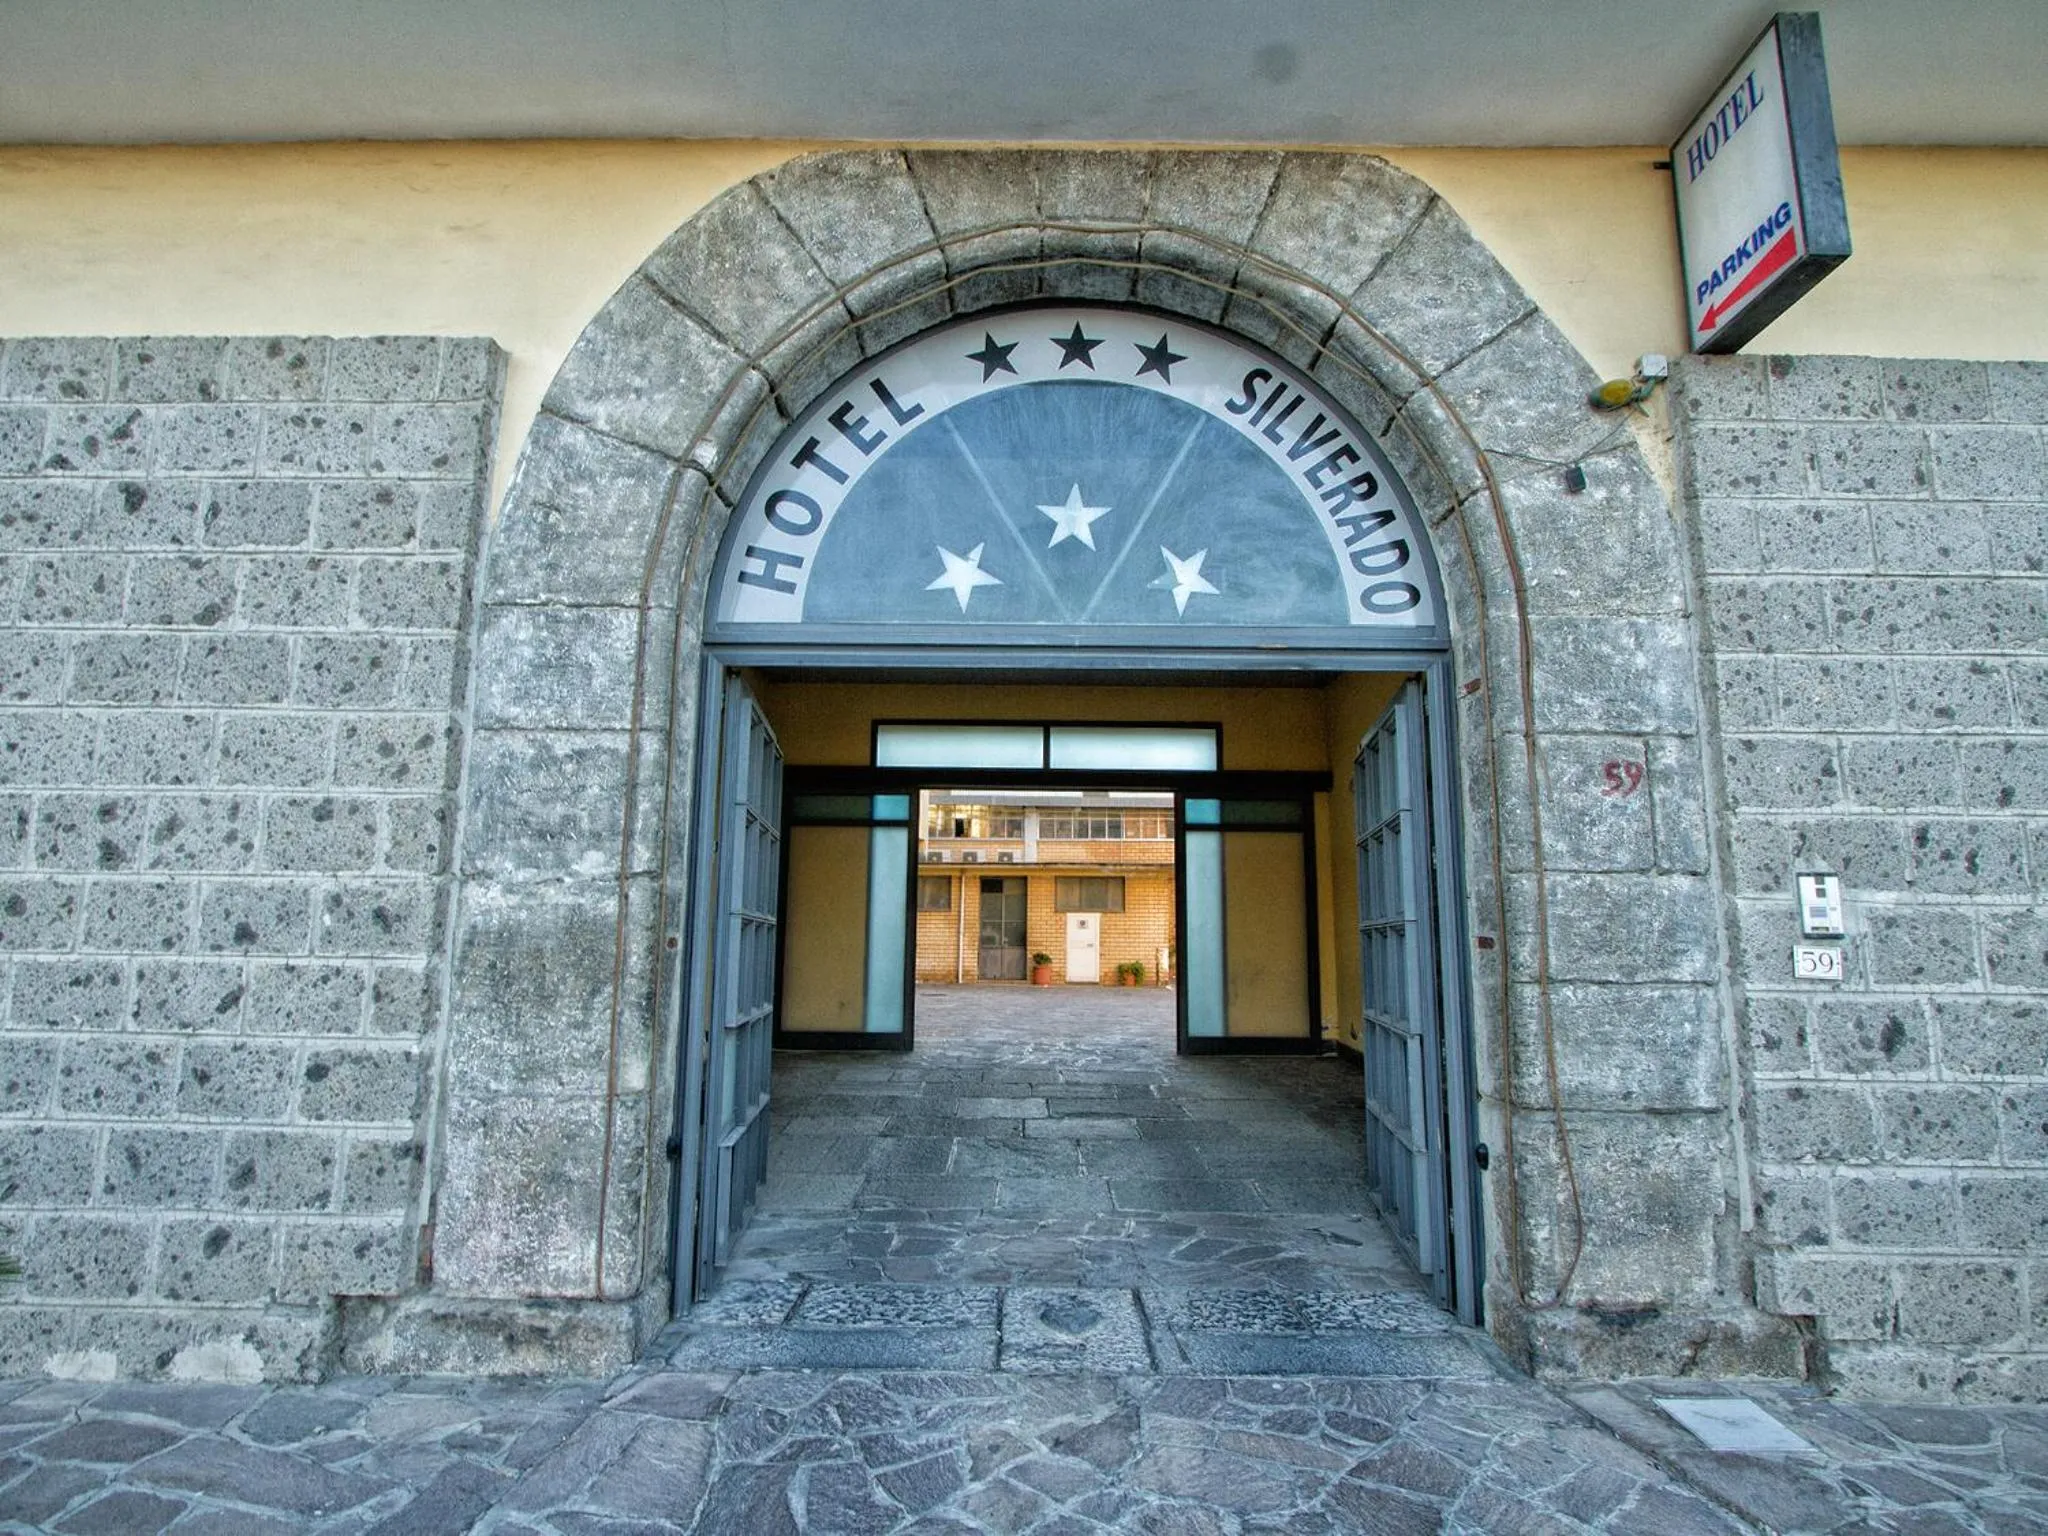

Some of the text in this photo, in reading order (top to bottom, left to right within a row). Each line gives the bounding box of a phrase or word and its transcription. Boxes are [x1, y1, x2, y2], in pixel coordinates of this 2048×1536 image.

[1687, 70, 1764, 184] HOTEL
[1697, 201, 1793, 306] PARKING
[738, 368, 1421, 614] HOTEL SILVERADO
[1801, 951, 1833, 973] 59
